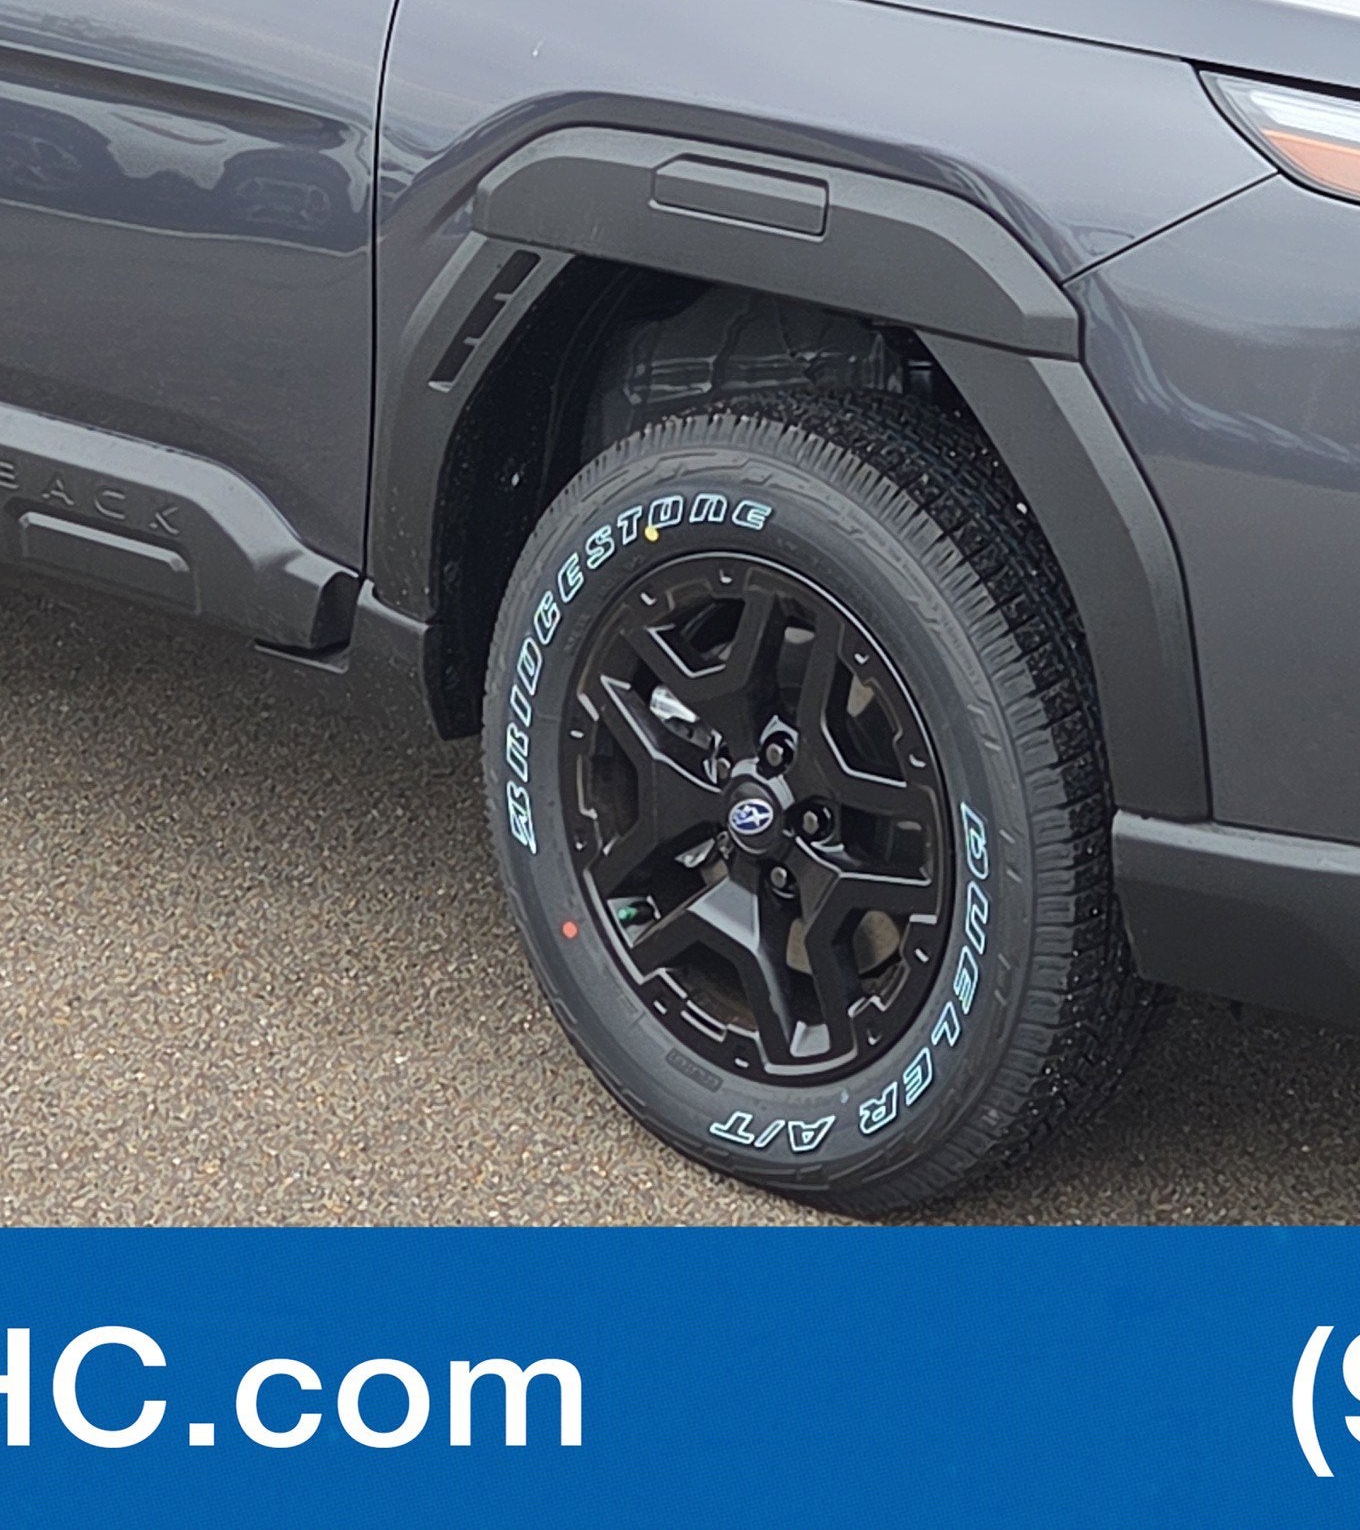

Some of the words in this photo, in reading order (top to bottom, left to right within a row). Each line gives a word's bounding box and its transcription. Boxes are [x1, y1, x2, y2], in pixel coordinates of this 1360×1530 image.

[502, 490, 774, 854] BRIDGESTONE
[707, 1109, 837, 1153] A/T
[857, 801, 991, 1137] DUELER
